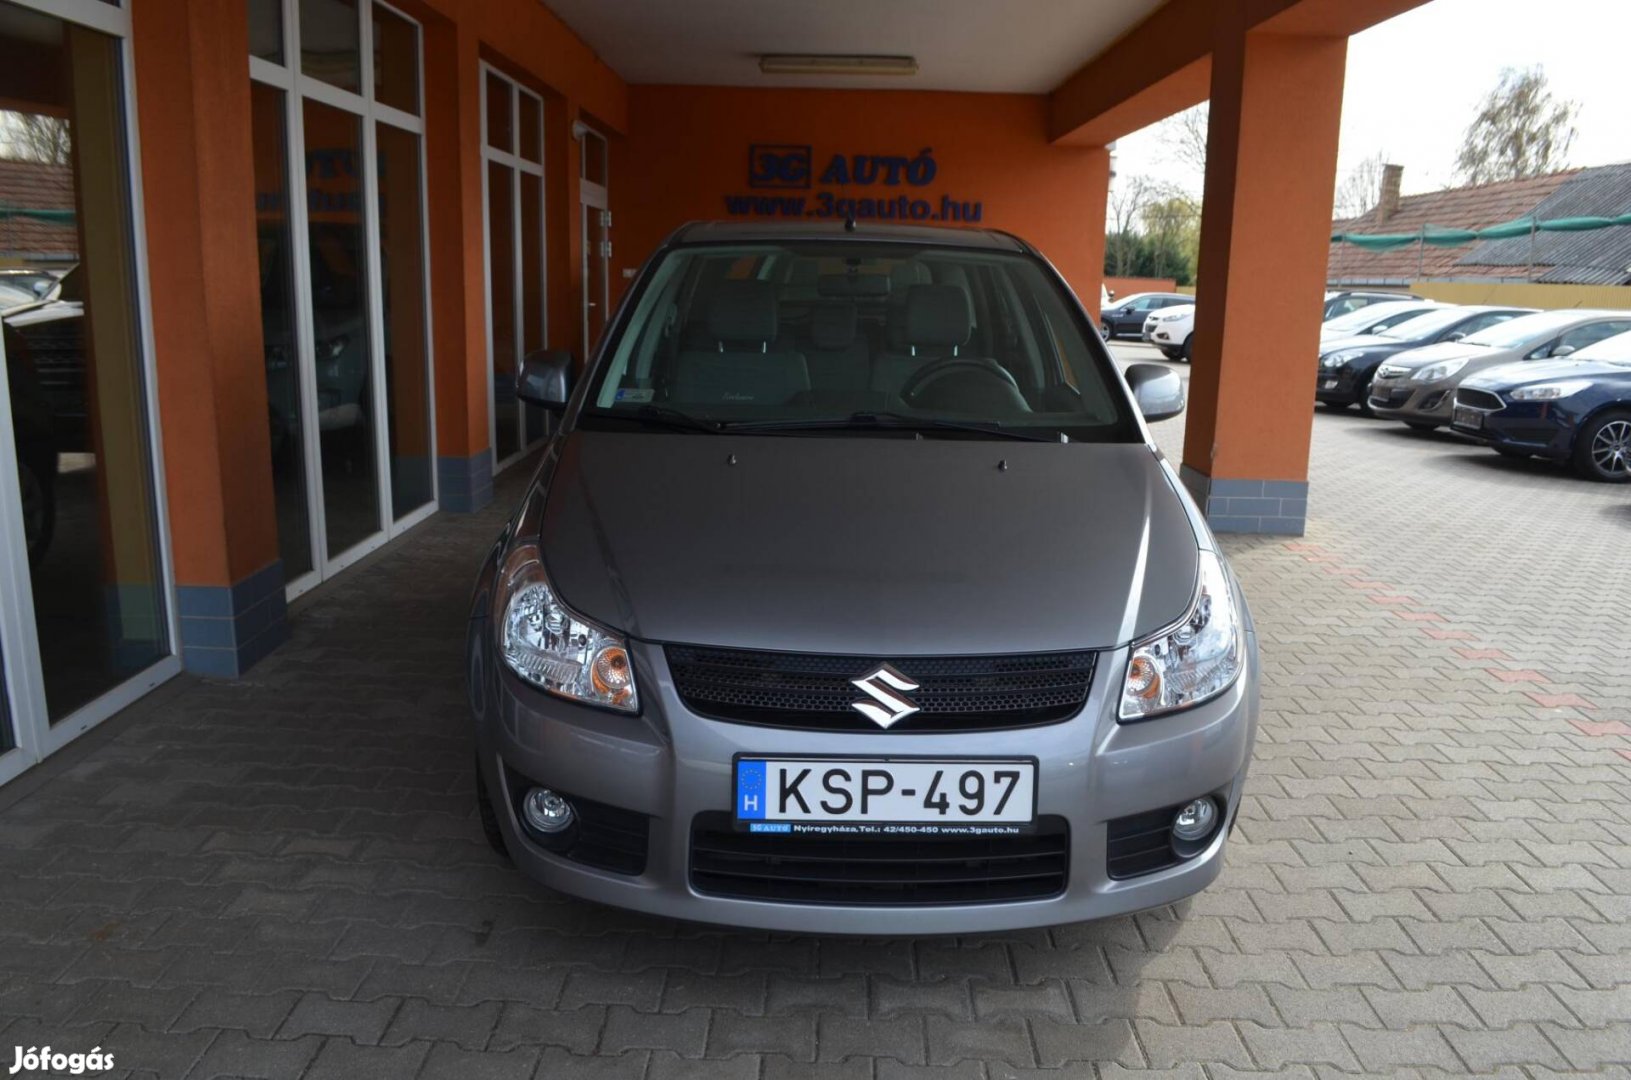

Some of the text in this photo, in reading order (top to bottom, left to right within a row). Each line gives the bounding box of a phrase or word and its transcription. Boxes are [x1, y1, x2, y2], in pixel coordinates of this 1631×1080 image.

[750, 146, 937, 186] 3G AUTÓ
[724, 191, 983, 222] www.3gauto.hu
[743, 794, 758, 811] H
[778, 768, 1021, 815] KSP-497
[883, 825, 939, 834] 42/450-450
[941, 826, 1020, 835] www.3gauto.hu
